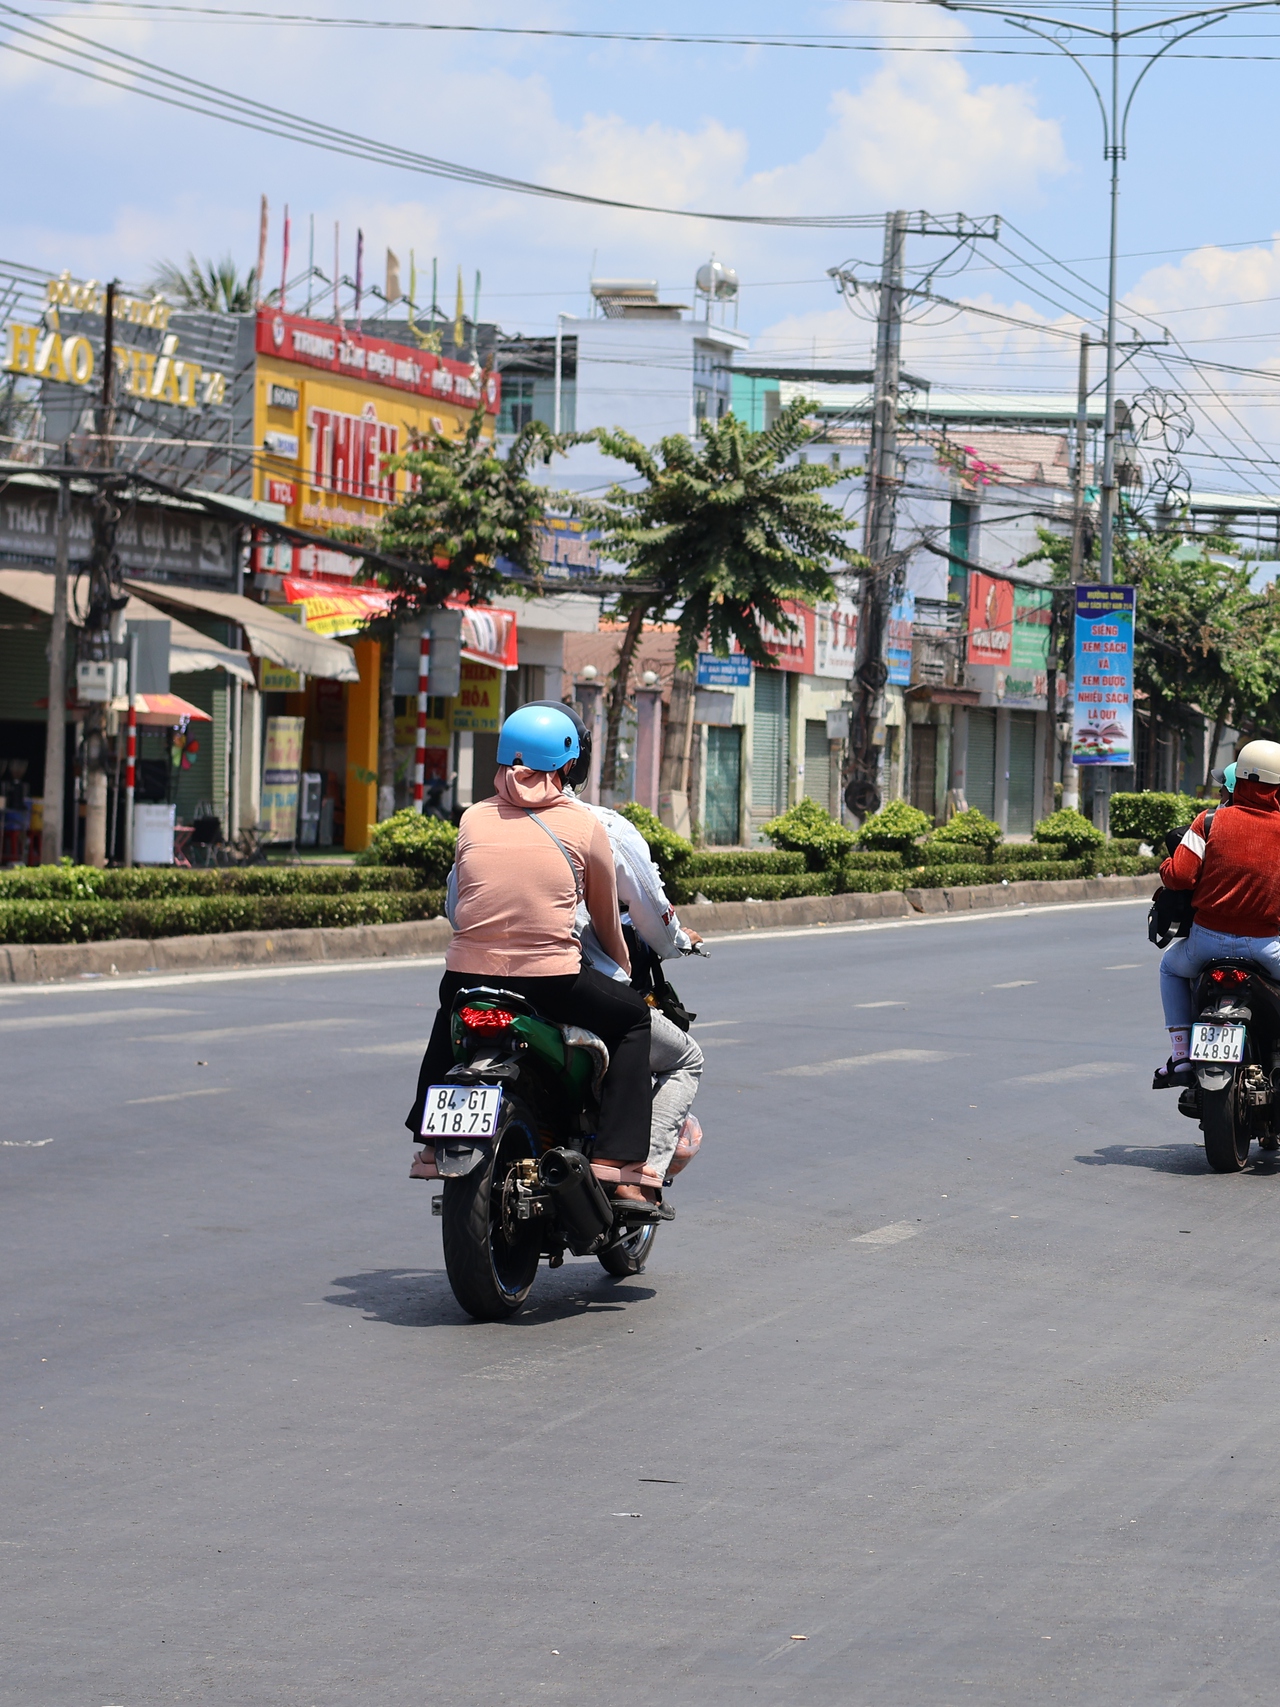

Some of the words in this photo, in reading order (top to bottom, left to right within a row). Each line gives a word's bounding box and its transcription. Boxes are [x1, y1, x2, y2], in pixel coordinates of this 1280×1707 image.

[2, 307, 94, 386] HÀO
[1082, 642, 1101, 653] XEM
[1103, 639, 1127, 654] SÁCH
[1081, 675, 1100, 687] XEM
[1200, 1026, 1237, 1043] 83-PT
[1193, 1043, 1240, 1060] 448.94
[436, 1089, 488, 1111] 84-G1
[426, 1112, 493, 1134] 418.75
